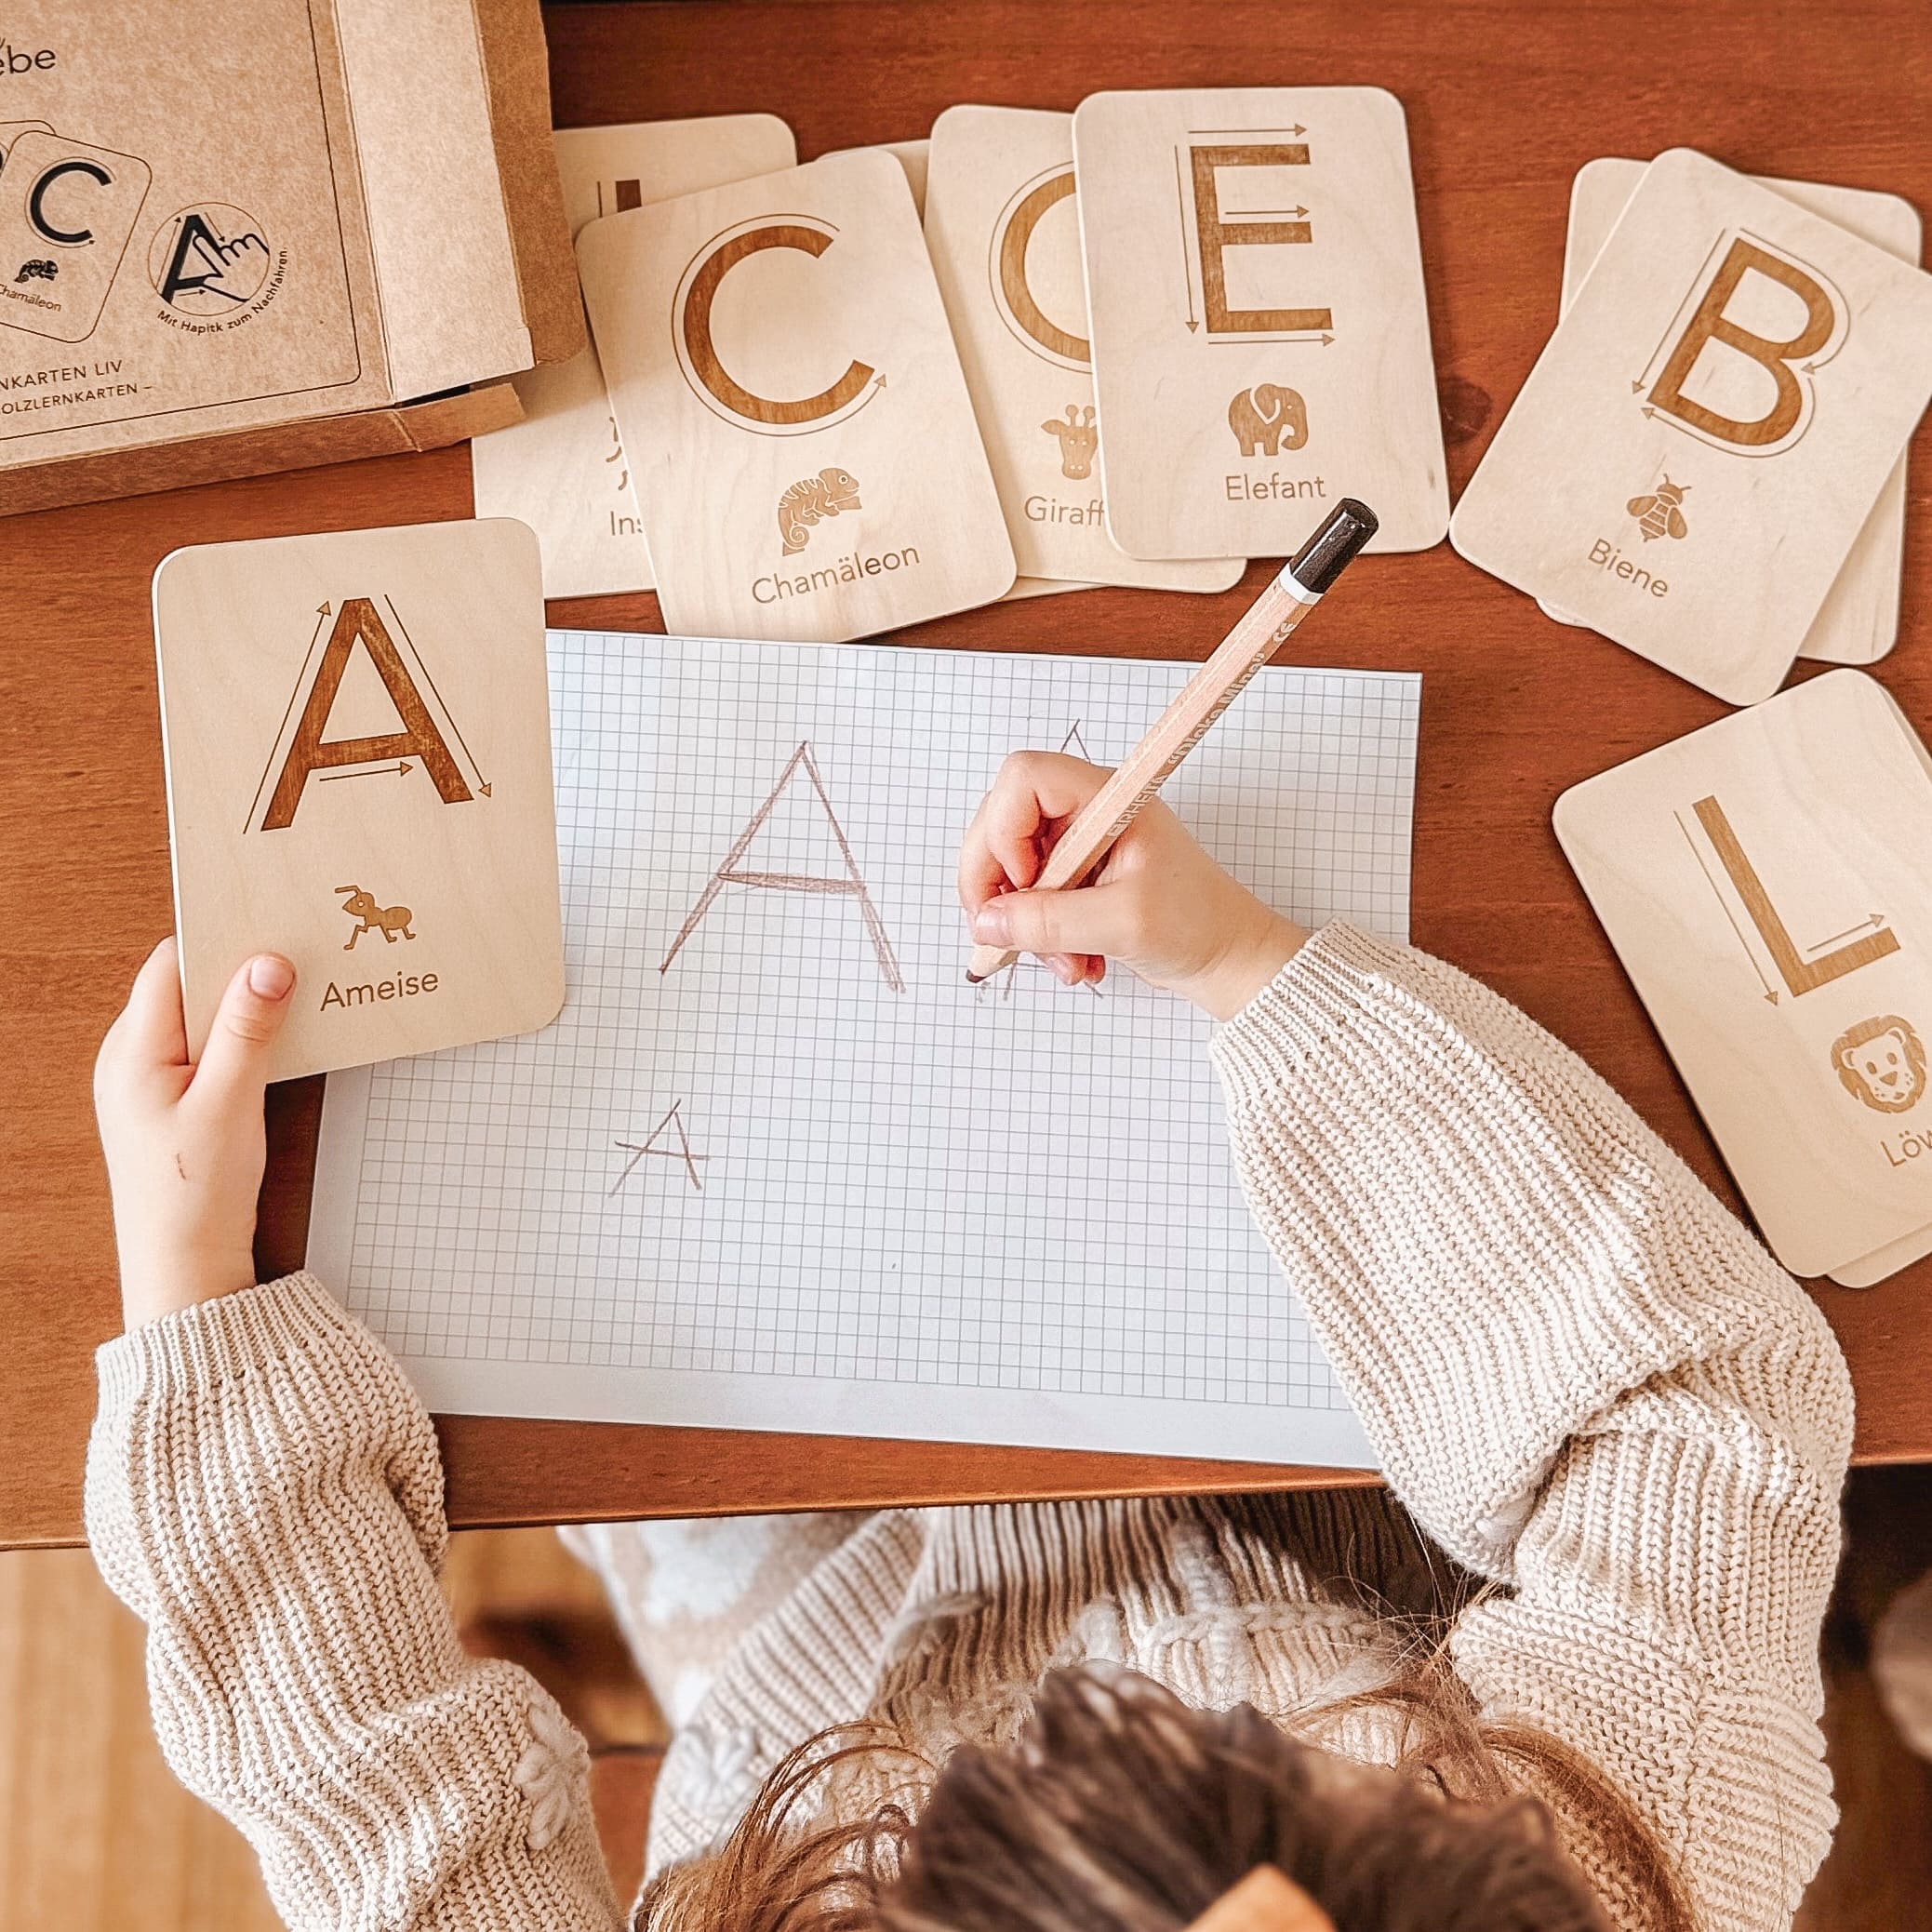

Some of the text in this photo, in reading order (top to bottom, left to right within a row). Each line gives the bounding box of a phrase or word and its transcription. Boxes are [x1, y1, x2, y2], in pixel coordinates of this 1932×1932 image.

[30, 161, 112, 244] C
[1190, 143, 1334, 333] E
[156, 310, 178, 327] Mit
[227, 314, 252, 329] zum
[683, 224, 875, 425] C
[1646, 237, 1834, 446] B
[1, 383, 138, 415] OLZLERNKARTEN
[94, 360, 123, 377] LIV
[1225, 472, 1326, 500] Elefant
[752, 546, 920, 604] Chamäleon
[1587, 538, 1670, 598] Biene
[260, 597, 475, 832] A
[659, 740, 907, 994] A
[1692, 794, 1901, 997] L
[320, 970, 440, 1013] Ameise
[608, 1099, 712, 1198] A
